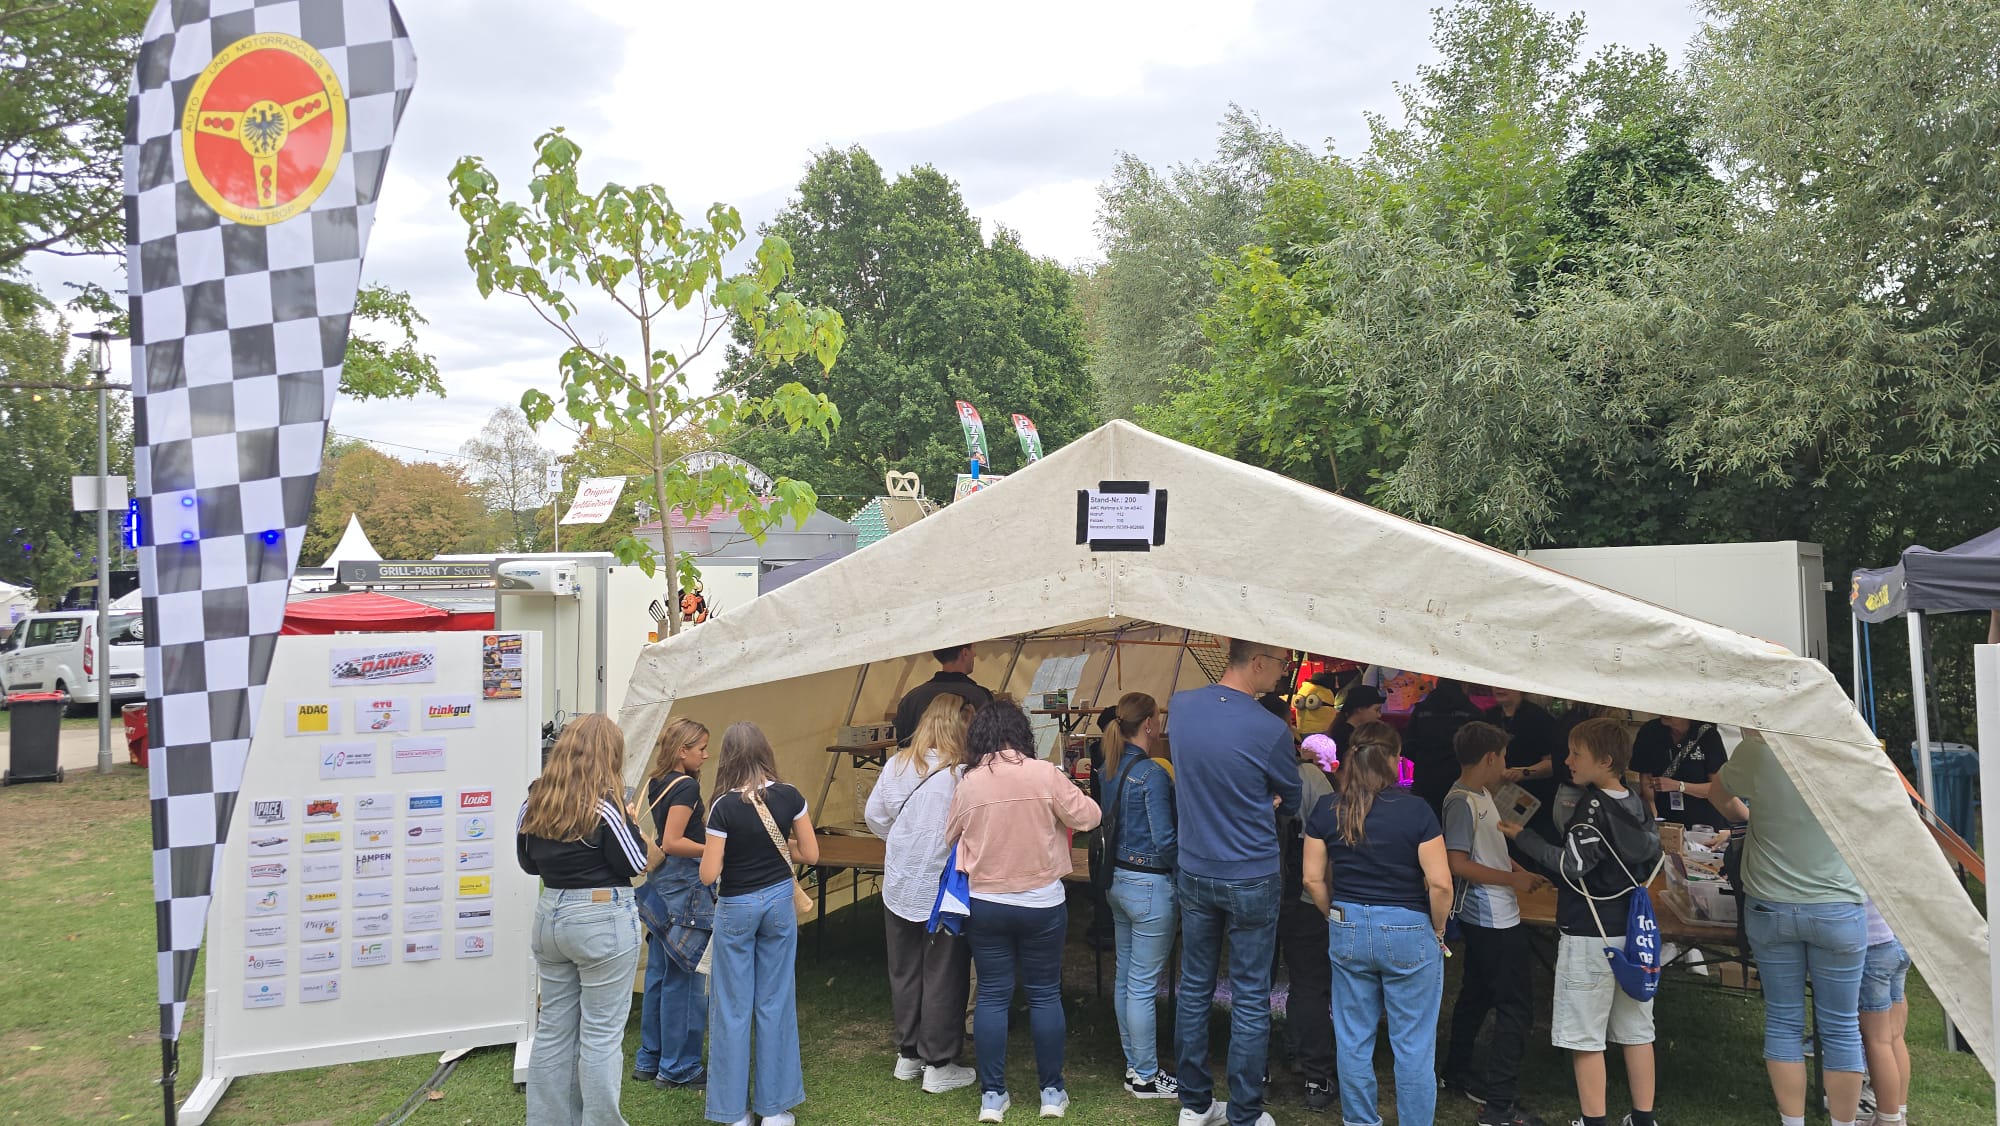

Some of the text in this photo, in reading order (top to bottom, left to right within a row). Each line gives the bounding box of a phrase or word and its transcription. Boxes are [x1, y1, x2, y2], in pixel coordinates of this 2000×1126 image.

[185, 96, 200, 132] AUTO
[209, 53, 230, 76] UND
[235, 36, 324, 69] MOTORRADCLUB
[583, 485, 616, 497] Original
[379, 566, 491, 576] GRILL-PARTY Service
[361, 653, 424, 673] DANKE
[299, 704, 328, 716] ADAC
[428, 703, 472, 717] trinkgut
[463, 793, 489, 805] Louis
[258, 801, 281, 816] PACE
